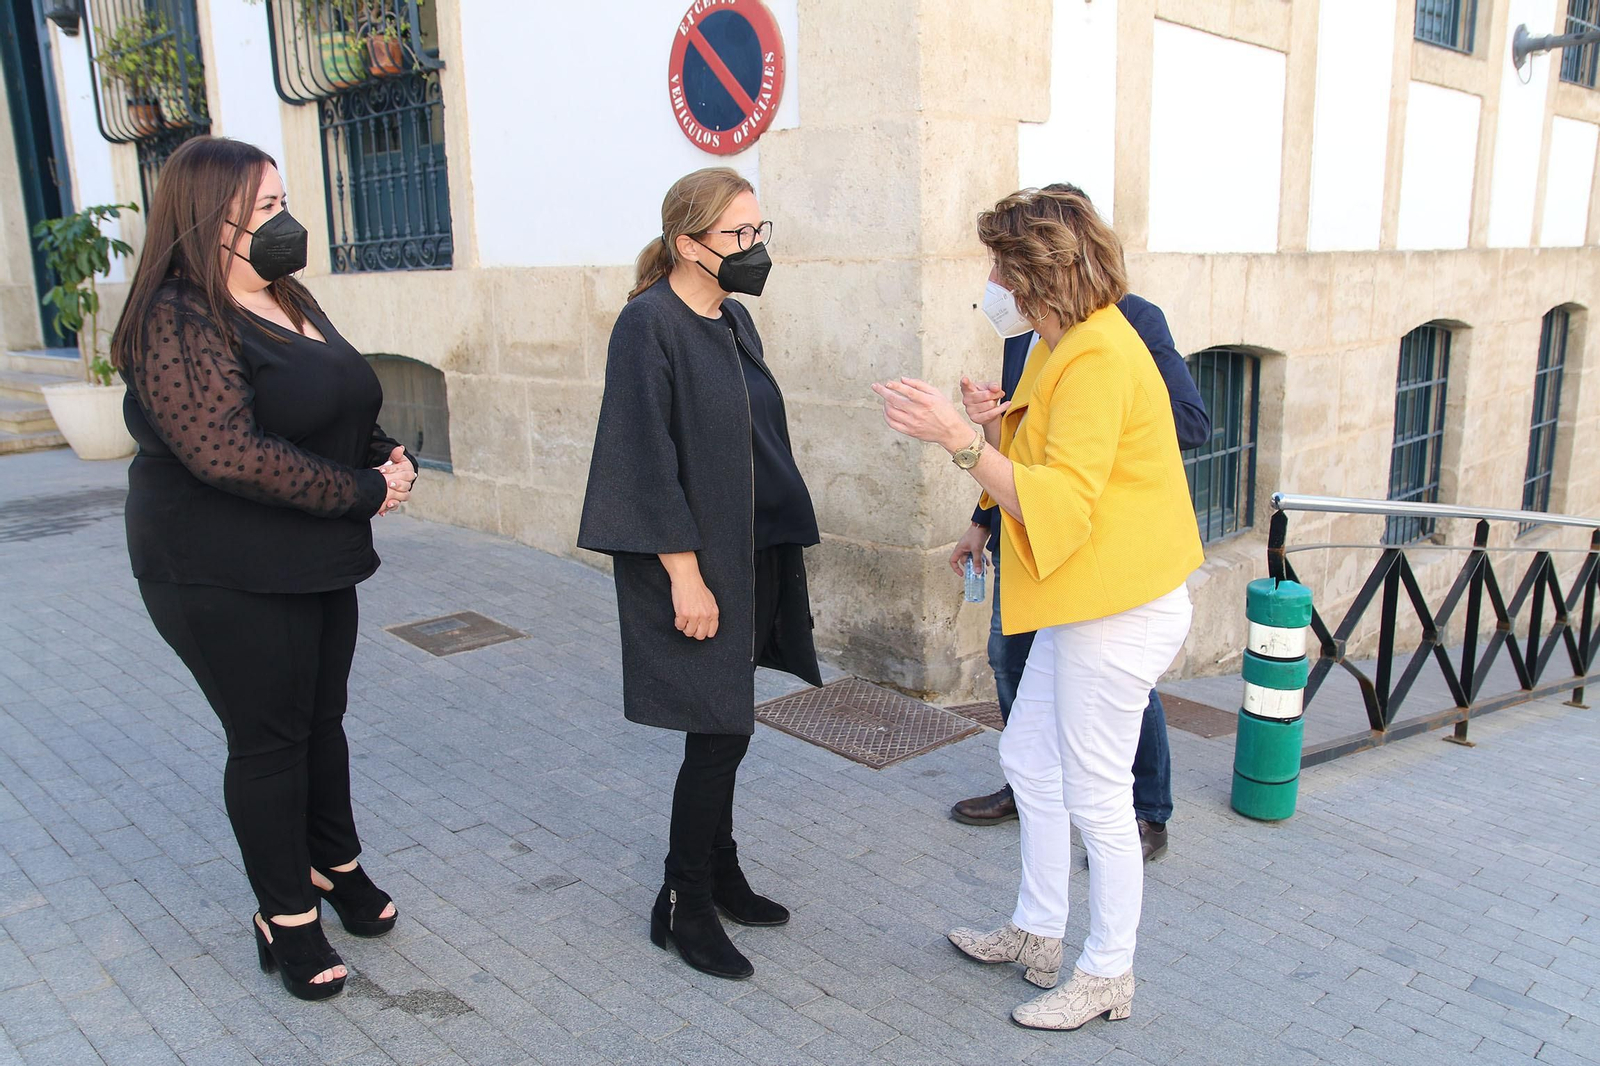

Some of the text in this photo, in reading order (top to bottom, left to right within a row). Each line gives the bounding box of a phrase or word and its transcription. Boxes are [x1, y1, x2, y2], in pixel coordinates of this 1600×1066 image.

[679, 0, 736, 37] EXCE
[670, 51, 775, 148] VEHICULOS OFICIALES
